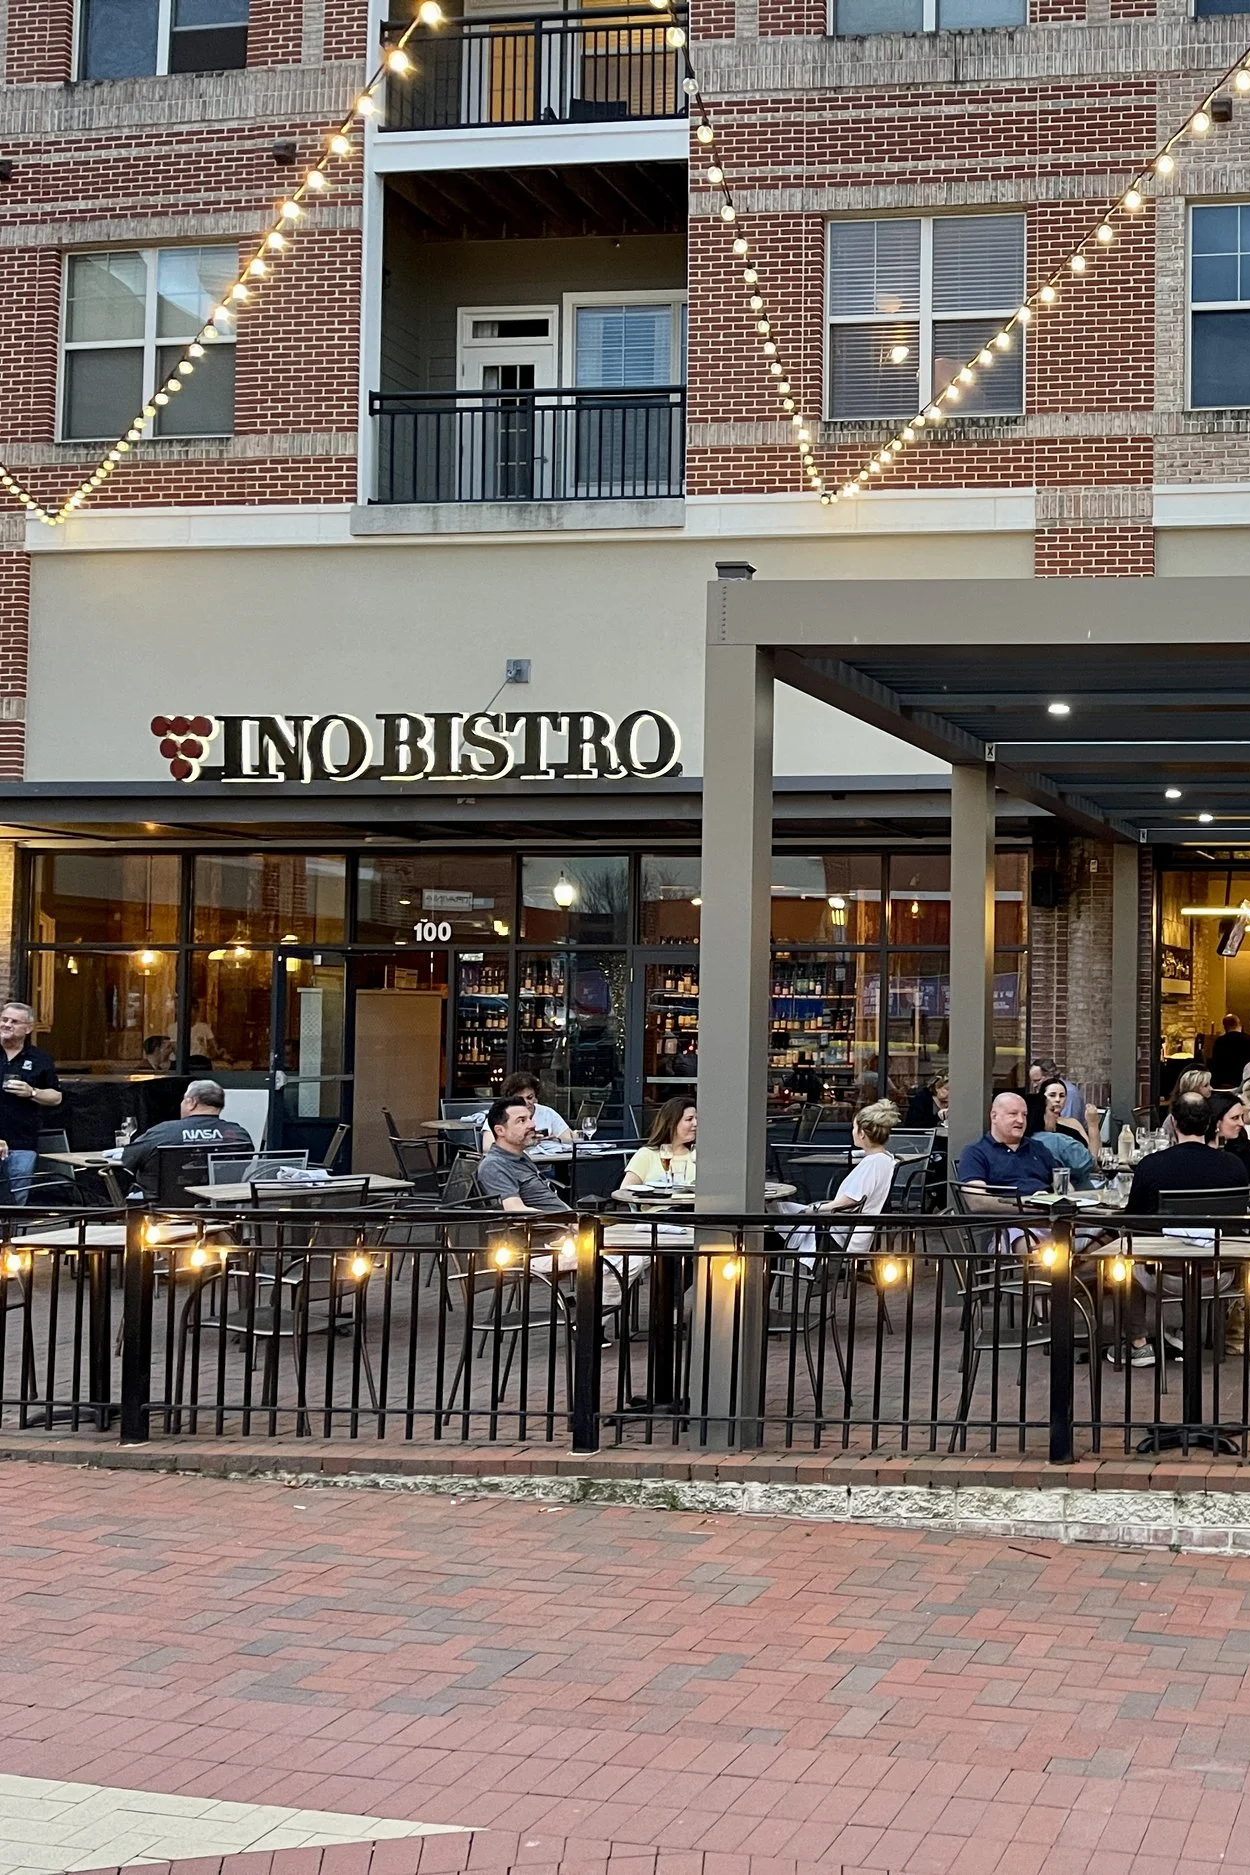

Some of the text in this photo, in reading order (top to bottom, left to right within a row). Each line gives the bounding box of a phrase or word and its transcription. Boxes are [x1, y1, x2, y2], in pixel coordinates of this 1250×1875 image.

[375, 710, 682, 782] BISTRO
[413, 921, 452, 942] 100
[182, 1128, 224, 1140] NASA
